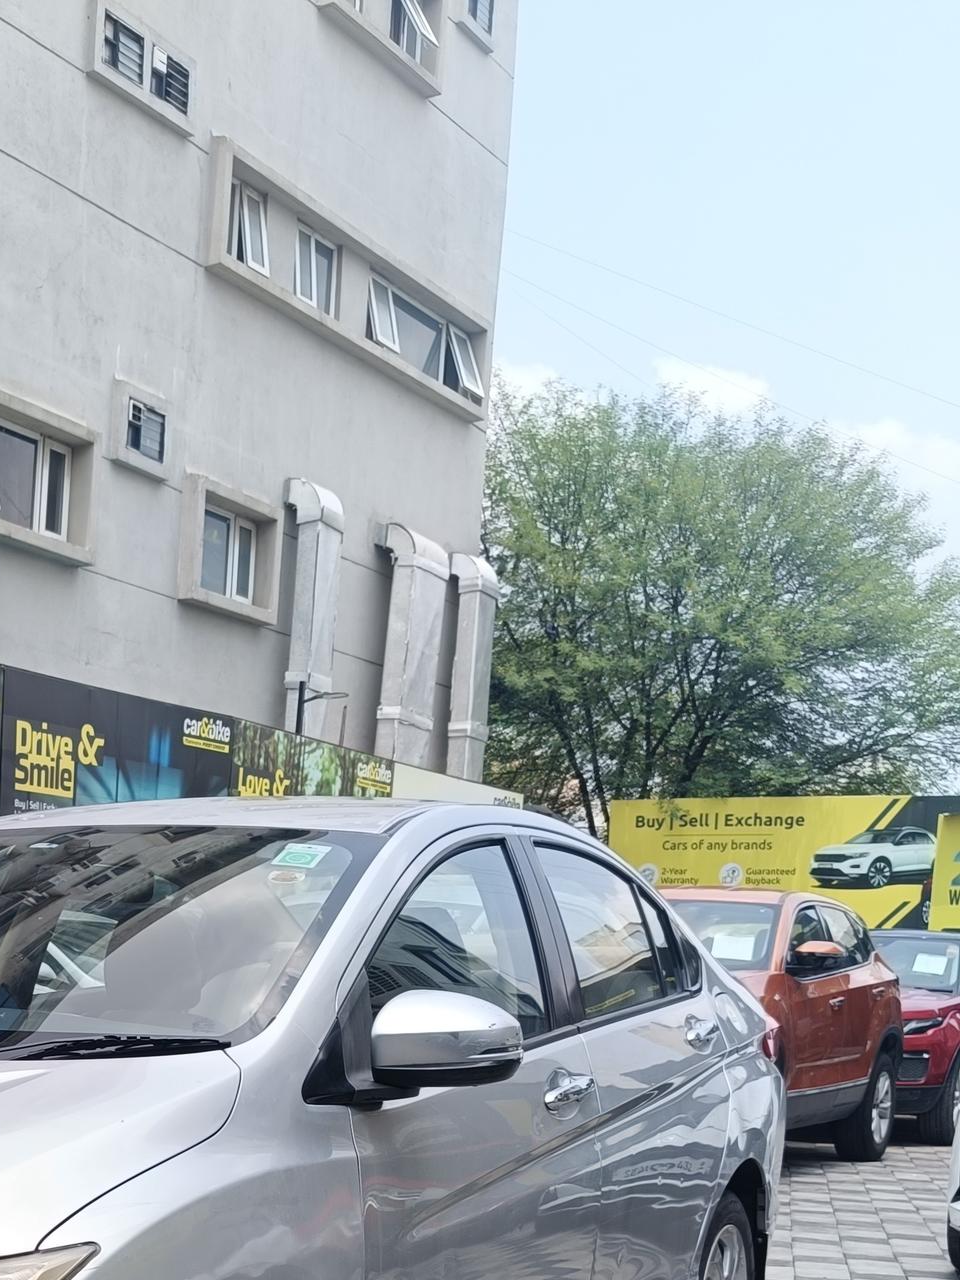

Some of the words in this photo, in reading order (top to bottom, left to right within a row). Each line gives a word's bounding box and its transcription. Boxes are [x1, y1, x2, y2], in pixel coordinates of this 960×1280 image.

[183, 717, 231, 743] car&bike
[16, 719, 73, 761] Drive
[78, 723, 105, 767] &
[15, 752, 73, 792] Smile
[238, 766, 270, 797] Love
[273, 768, 291, 797] &
[635, 815, 666, 831] Buy
[678, 813, 709, 827] Sell
[724, 812, 805, 830] Exchange
[662, 840, 688, 851] Cars
[691, 839, 704, 851] of
[706, 841, 727, 853] any
[731, 839, 772, 851] brands
[661, 867, 688, 875] 2-Year
[745, 867, 796, 876] Guaranteed
[660, 876, 699, 886] Warranty
[745, 877, 781, 886] Buyback
